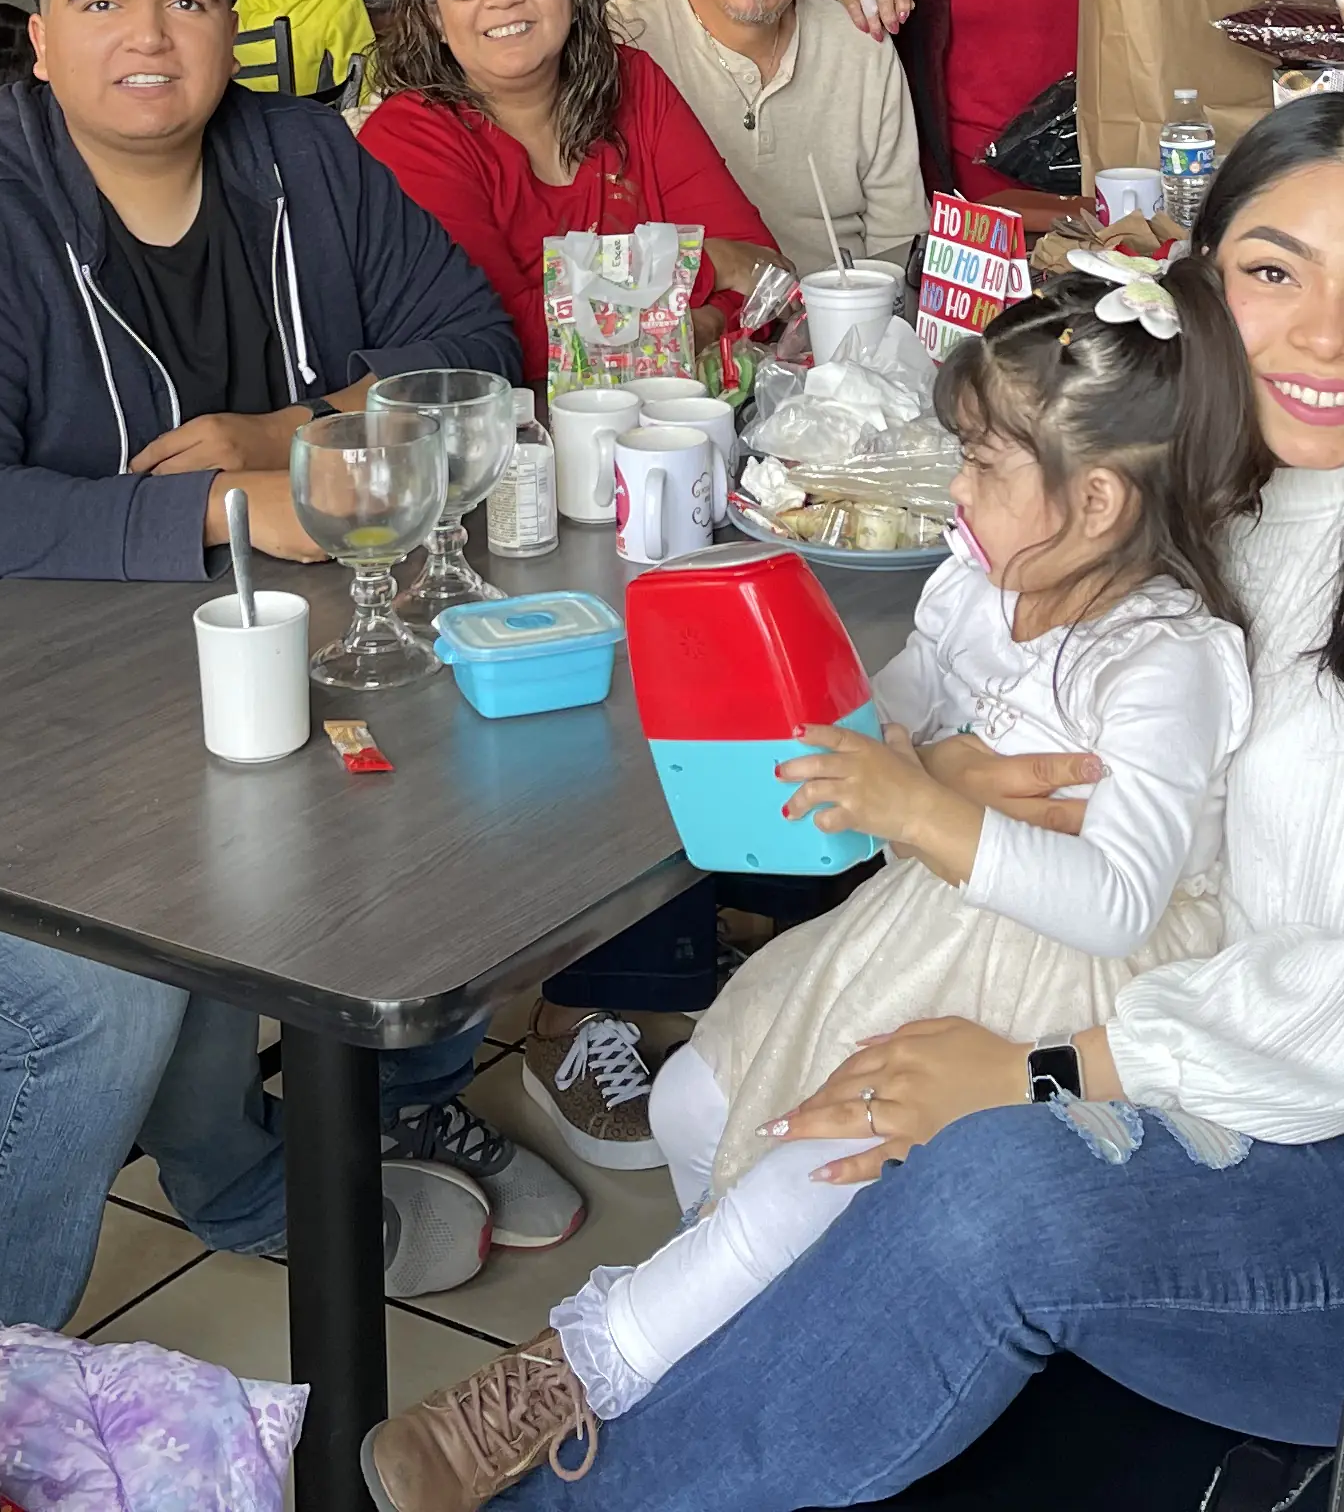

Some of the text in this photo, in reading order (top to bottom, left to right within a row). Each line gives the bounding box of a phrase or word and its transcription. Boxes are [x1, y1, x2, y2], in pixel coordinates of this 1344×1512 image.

[933, 201, 961, 236] HO
[962, 210, 990, 243] HO
[927, 240, 1004, 292] HO HO HO
[922, 279, 944, 312] HO
[945, 288, 971, 320] HO
